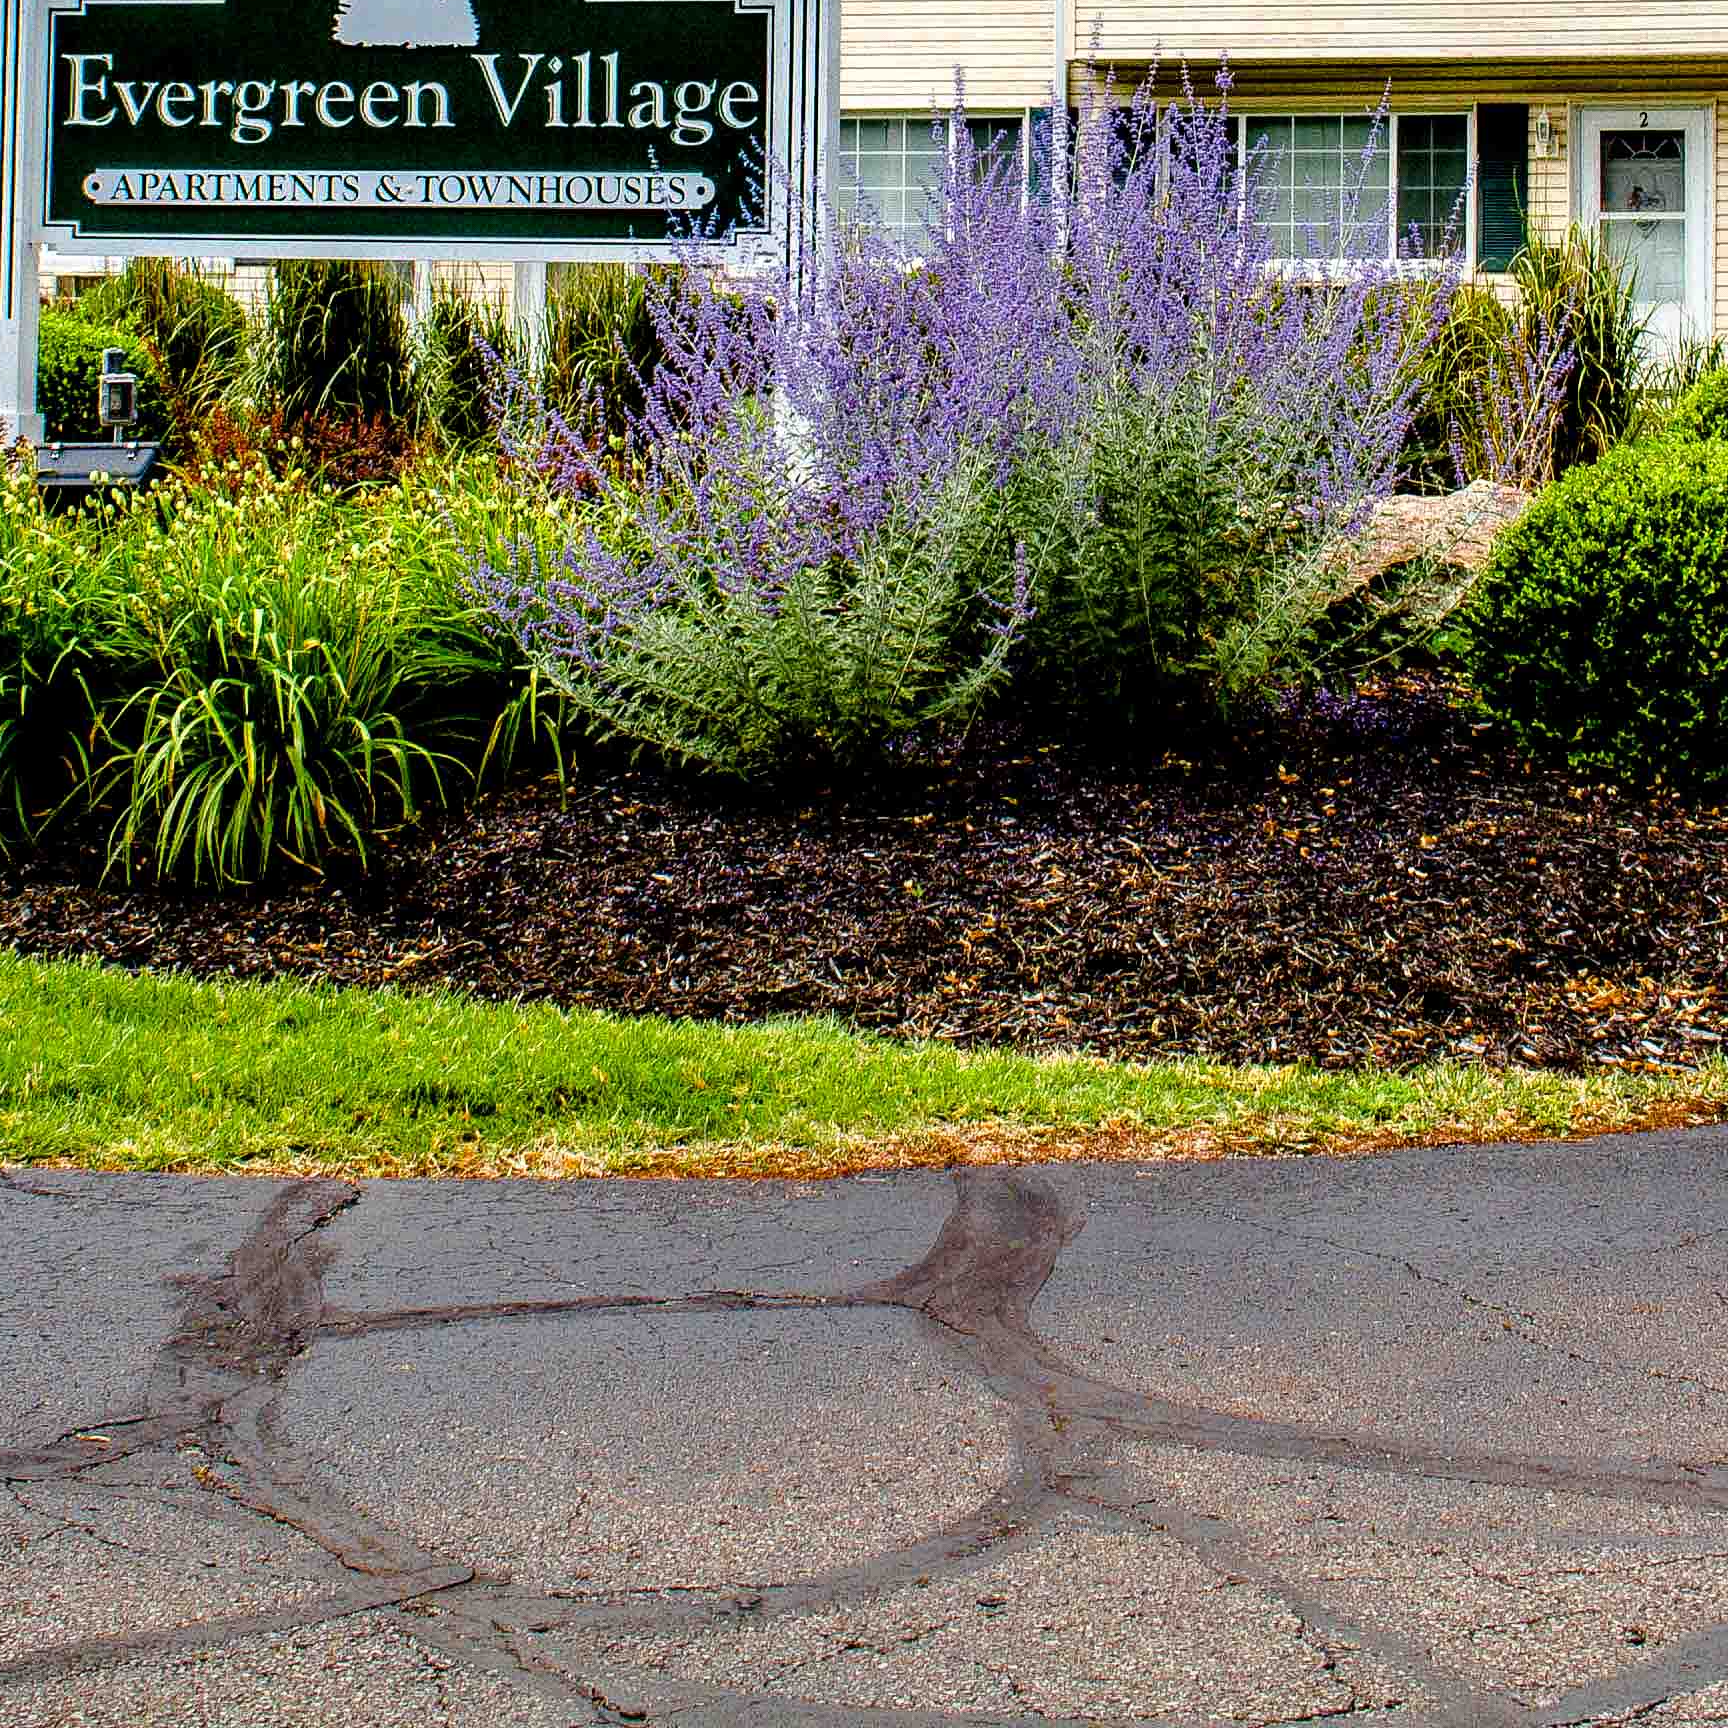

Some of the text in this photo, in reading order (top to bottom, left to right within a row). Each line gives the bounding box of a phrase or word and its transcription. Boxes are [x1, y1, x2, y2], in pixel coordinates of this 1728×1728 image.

[60, 51, 760, 146] Evergreen Village
[1639, 111, 1649, 129] 2
[110, 173, 686, 205] APARTMENTS & TOWNHOUSES
